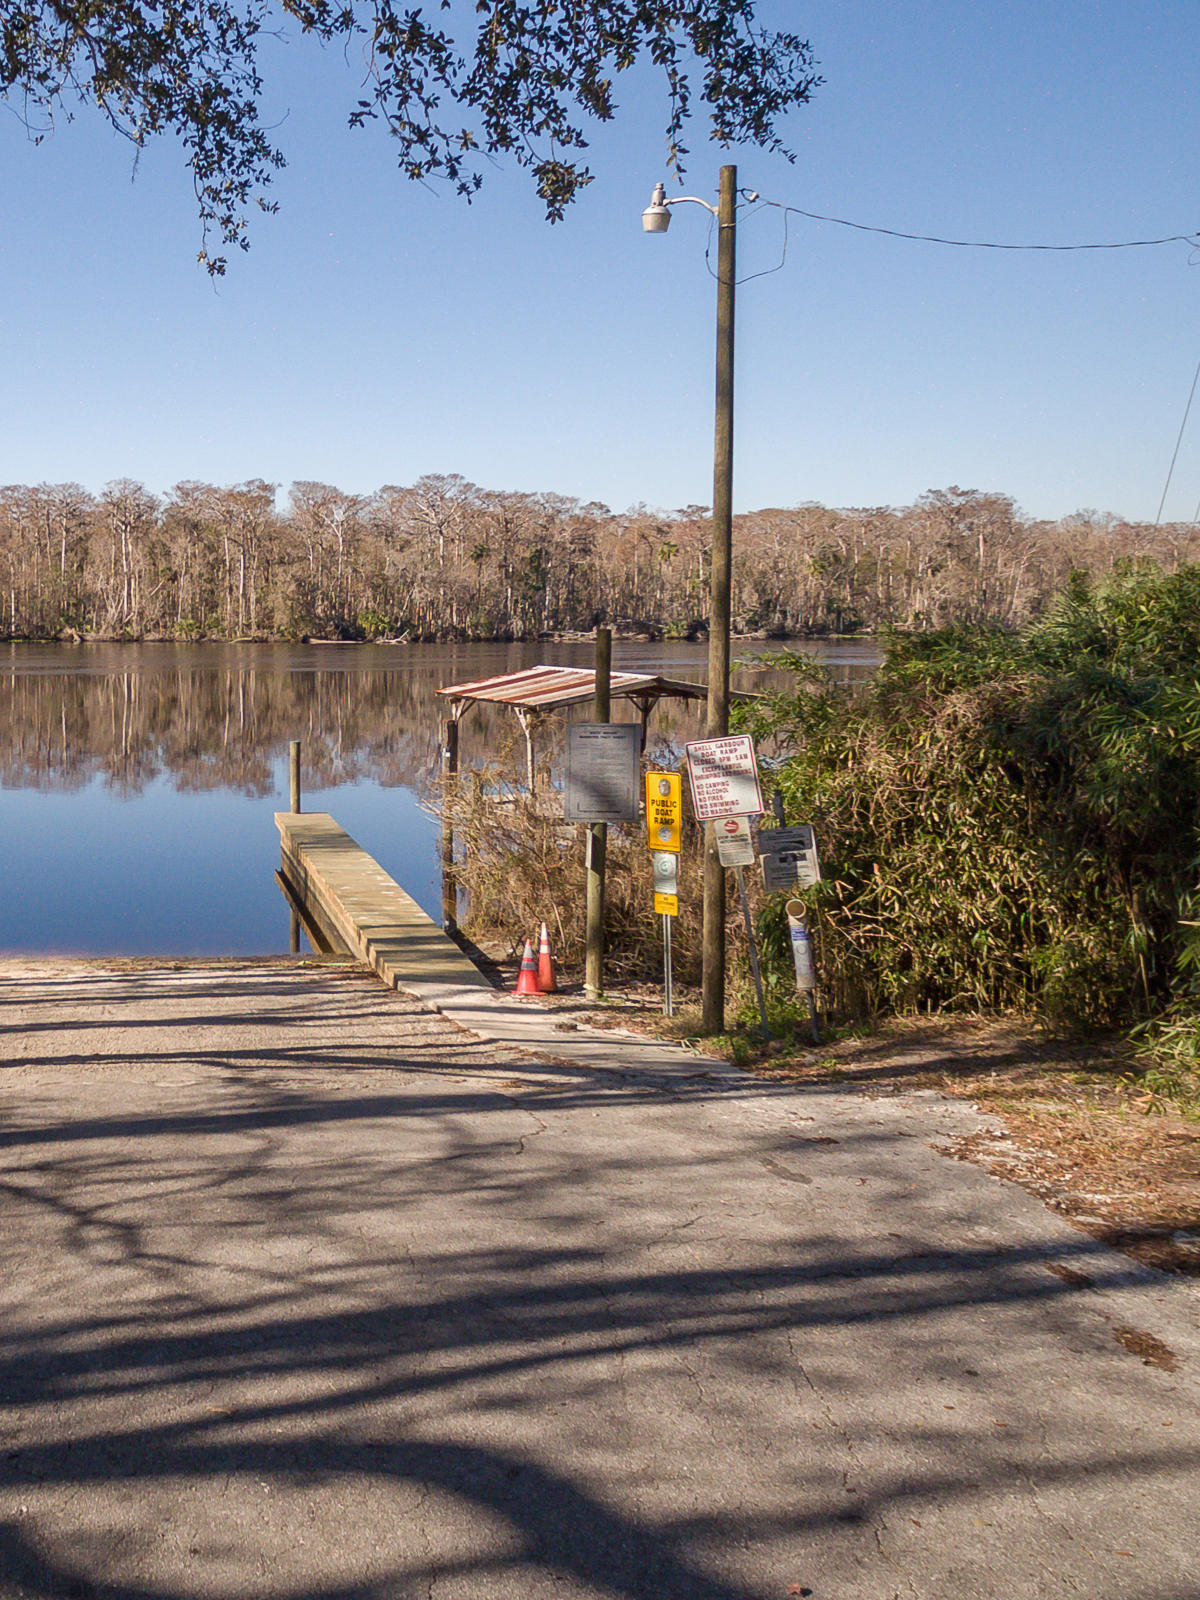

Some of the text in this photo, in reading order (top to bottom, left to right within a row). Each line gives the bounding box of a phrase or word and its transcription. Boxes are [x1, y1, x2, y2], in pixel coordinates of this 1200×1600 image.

[694, 745, 712, 753] SHELL
[701, 747, 738, 758] BOAT RAMP
[694, 757, 716, 766] CLOSED
[702, 765, 720, 773] EXCEPT
[722, 769, 732, 777] AND
[705, 780, 729, 789] CAMPING
[706, 787, 729, 796] ALCOHOL
[708, 794, 723, 802] FIRES
[651, 799, 678, 808] PUBLIC
[709, 799, 740, 809] SWIMMING
[655, 808, 673, 817] BOAT
[710, 807, 733, 815] WADING
[654, 816, 675, 825] RAMP
